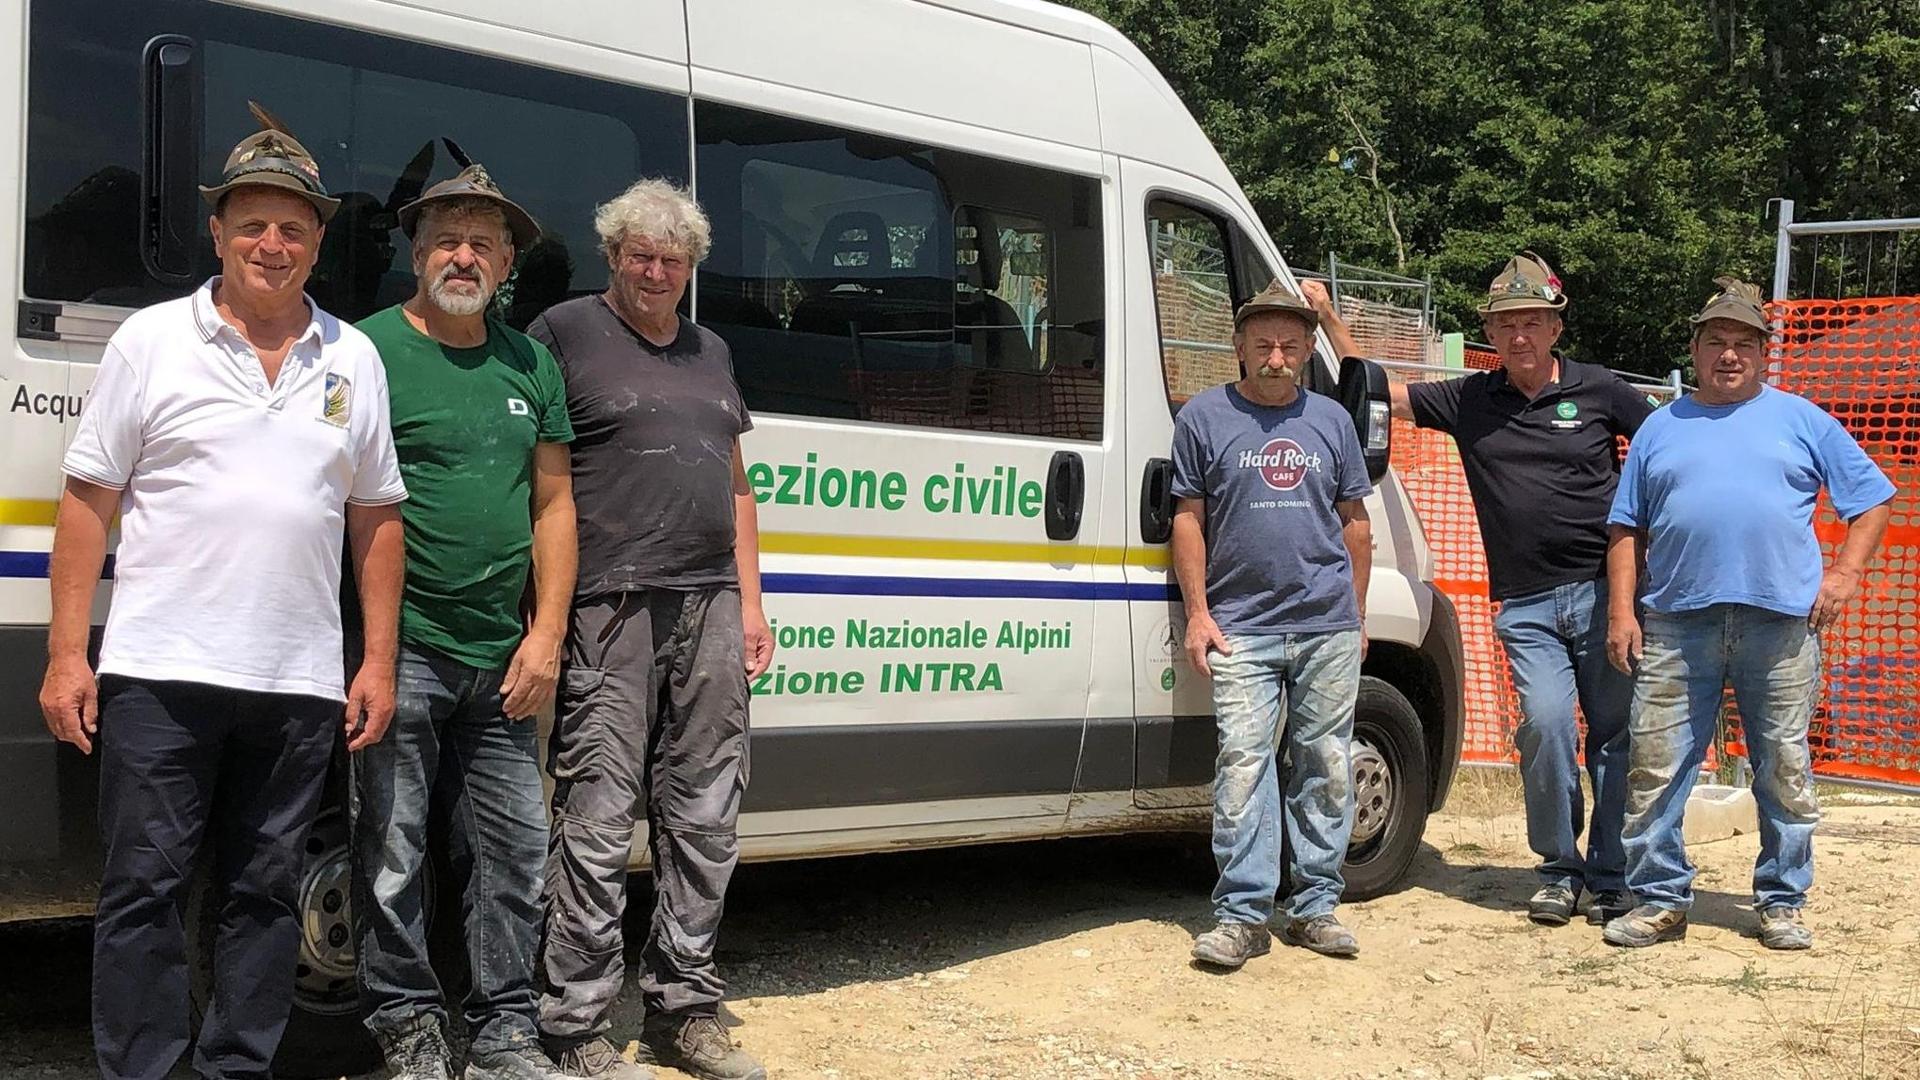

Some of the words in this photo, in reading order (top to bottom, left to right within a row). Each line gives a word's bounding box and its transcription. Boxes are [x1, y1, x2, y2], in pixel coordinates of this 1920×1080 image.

[10, 384, 90, 423] Acqu
[1238, 449, 1282, 468] Hard
[1284, 448, 1321, 472] Rock
[747, 453, 907, 511] ezione
[924, 464, 1043, 518] civile
[1272, 472, 1295, 481] CAFE
[1249, 501, 1276, 509] SANTO
[846, 619, 988, 649] Nazionale
[996, 621, 1072, 655] Alpini
[752, 664, 865, 695] zione
[880, 663, 1004, 693] INTRA
